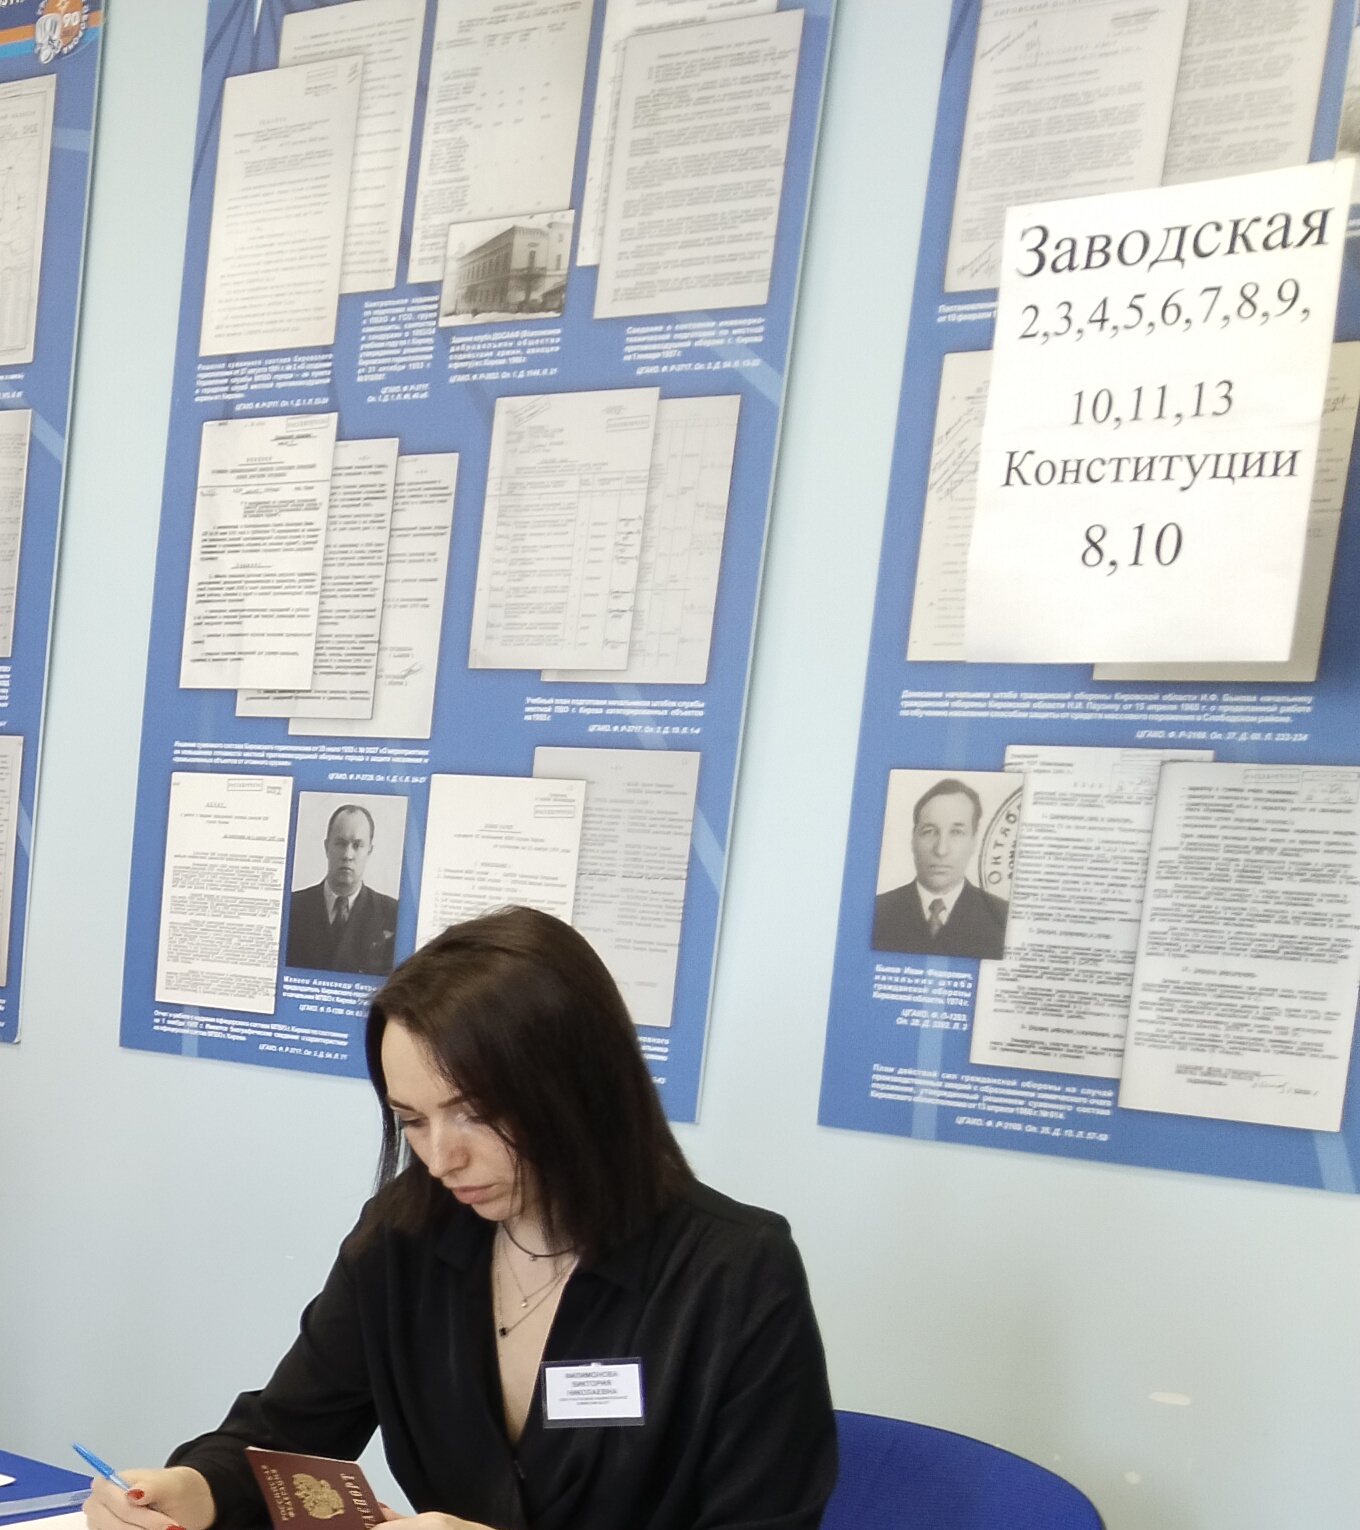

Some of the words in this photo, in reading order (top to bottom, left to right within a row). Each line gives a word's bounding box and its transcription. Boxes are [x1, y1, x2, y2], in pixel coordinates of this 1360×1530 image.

[63, 11, 80, 27] 90
[1016, 207, 1333, 278] Заводская
[1018, 277, 1311, 343] 2,3,4,5,6,7,8,9,
[1070, 379, 1235, 430] 10,11,13
[1001, 448, 1302, 492] Конституции
[1080, 522, 1184, 577] 8,10
